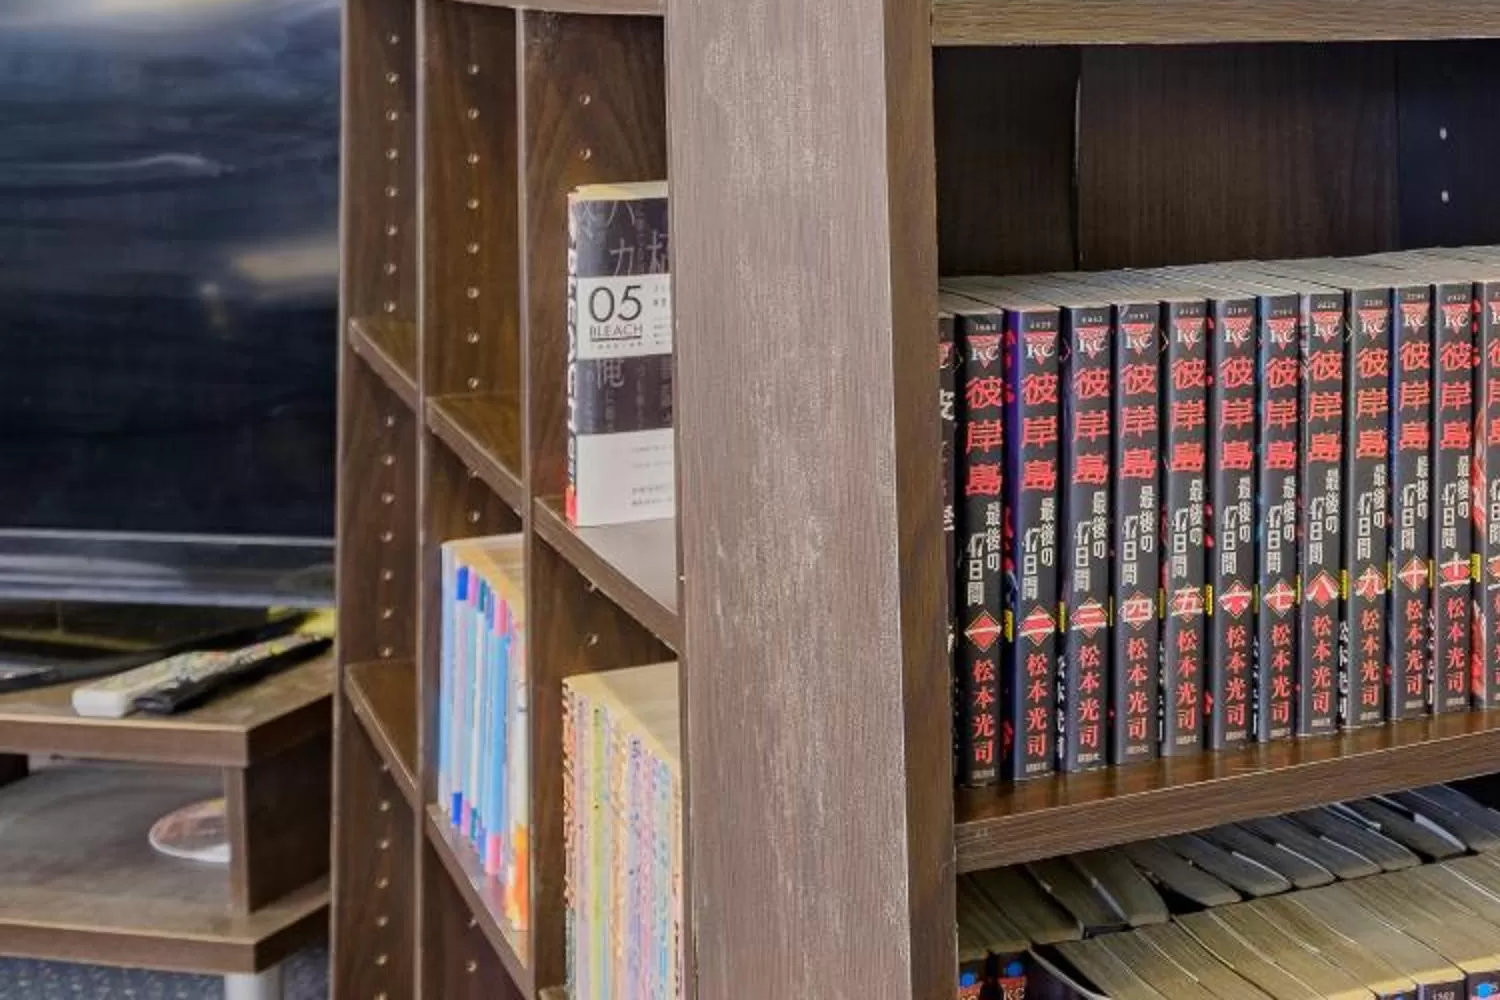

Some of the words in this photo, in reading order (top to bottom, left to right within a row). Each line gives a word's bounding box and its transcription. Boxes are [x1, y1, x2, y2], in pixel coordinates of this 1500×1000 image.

[589, 285, 643, 323] 05
[965, 376, 1003, 497] 彼岸島
[1021, 372, 1058, 493] 彼岸島
[1072, 367, 1110, 486] 彼岸島
[1120, 363, 1157, 480] 彼岸島
[1171, 356, 1206, 472] 彼岸島
[1220, 355, 1255, 471] 彼岸島
[1265, 356, 1298, 470] 彼岸島
[1308, 350, 1343, 463] 彼岸島
[1356, 348, 1389, 459] 彼岸島
[1399, 341, 1430, 450] 彼岸島
[1440, 341, 1472, 450] 彼岸島
[1071, 603, 1108, 631] 三
[1122, 598, 1153, 623] 四
[1170, 587, 1204, 616] 五
[1218, 583, 1252, 612] 六
[1265, 581, 1296, 603] 七
[1306, 576, 1339, 599] 八
[1356, 567, 1387, 596] 九
[1399, 562, 1429, 591] 十
[1440, 551, 1471, 588] 十一
[1127, 637, 1149, 740] 松本光司
[1176, 629, 1198, 730] 松本光司
[1226, 625, 1247, 726] 松本光司
[1271, 623, 1291, 724] 松本光司
[1311, 615, 1333, 714] 松本光司
[1361, 608, 1381, 706] 松本光司
[1405, 599, 1423, 696] 松本光司
[1446, 597, 1465, 693] 松本光司
[972, 659, 996, 765] 松本光司
[1026, 653, 1049, 757] 松本光司
[1078, 645, 1101, 748] 松本光司
